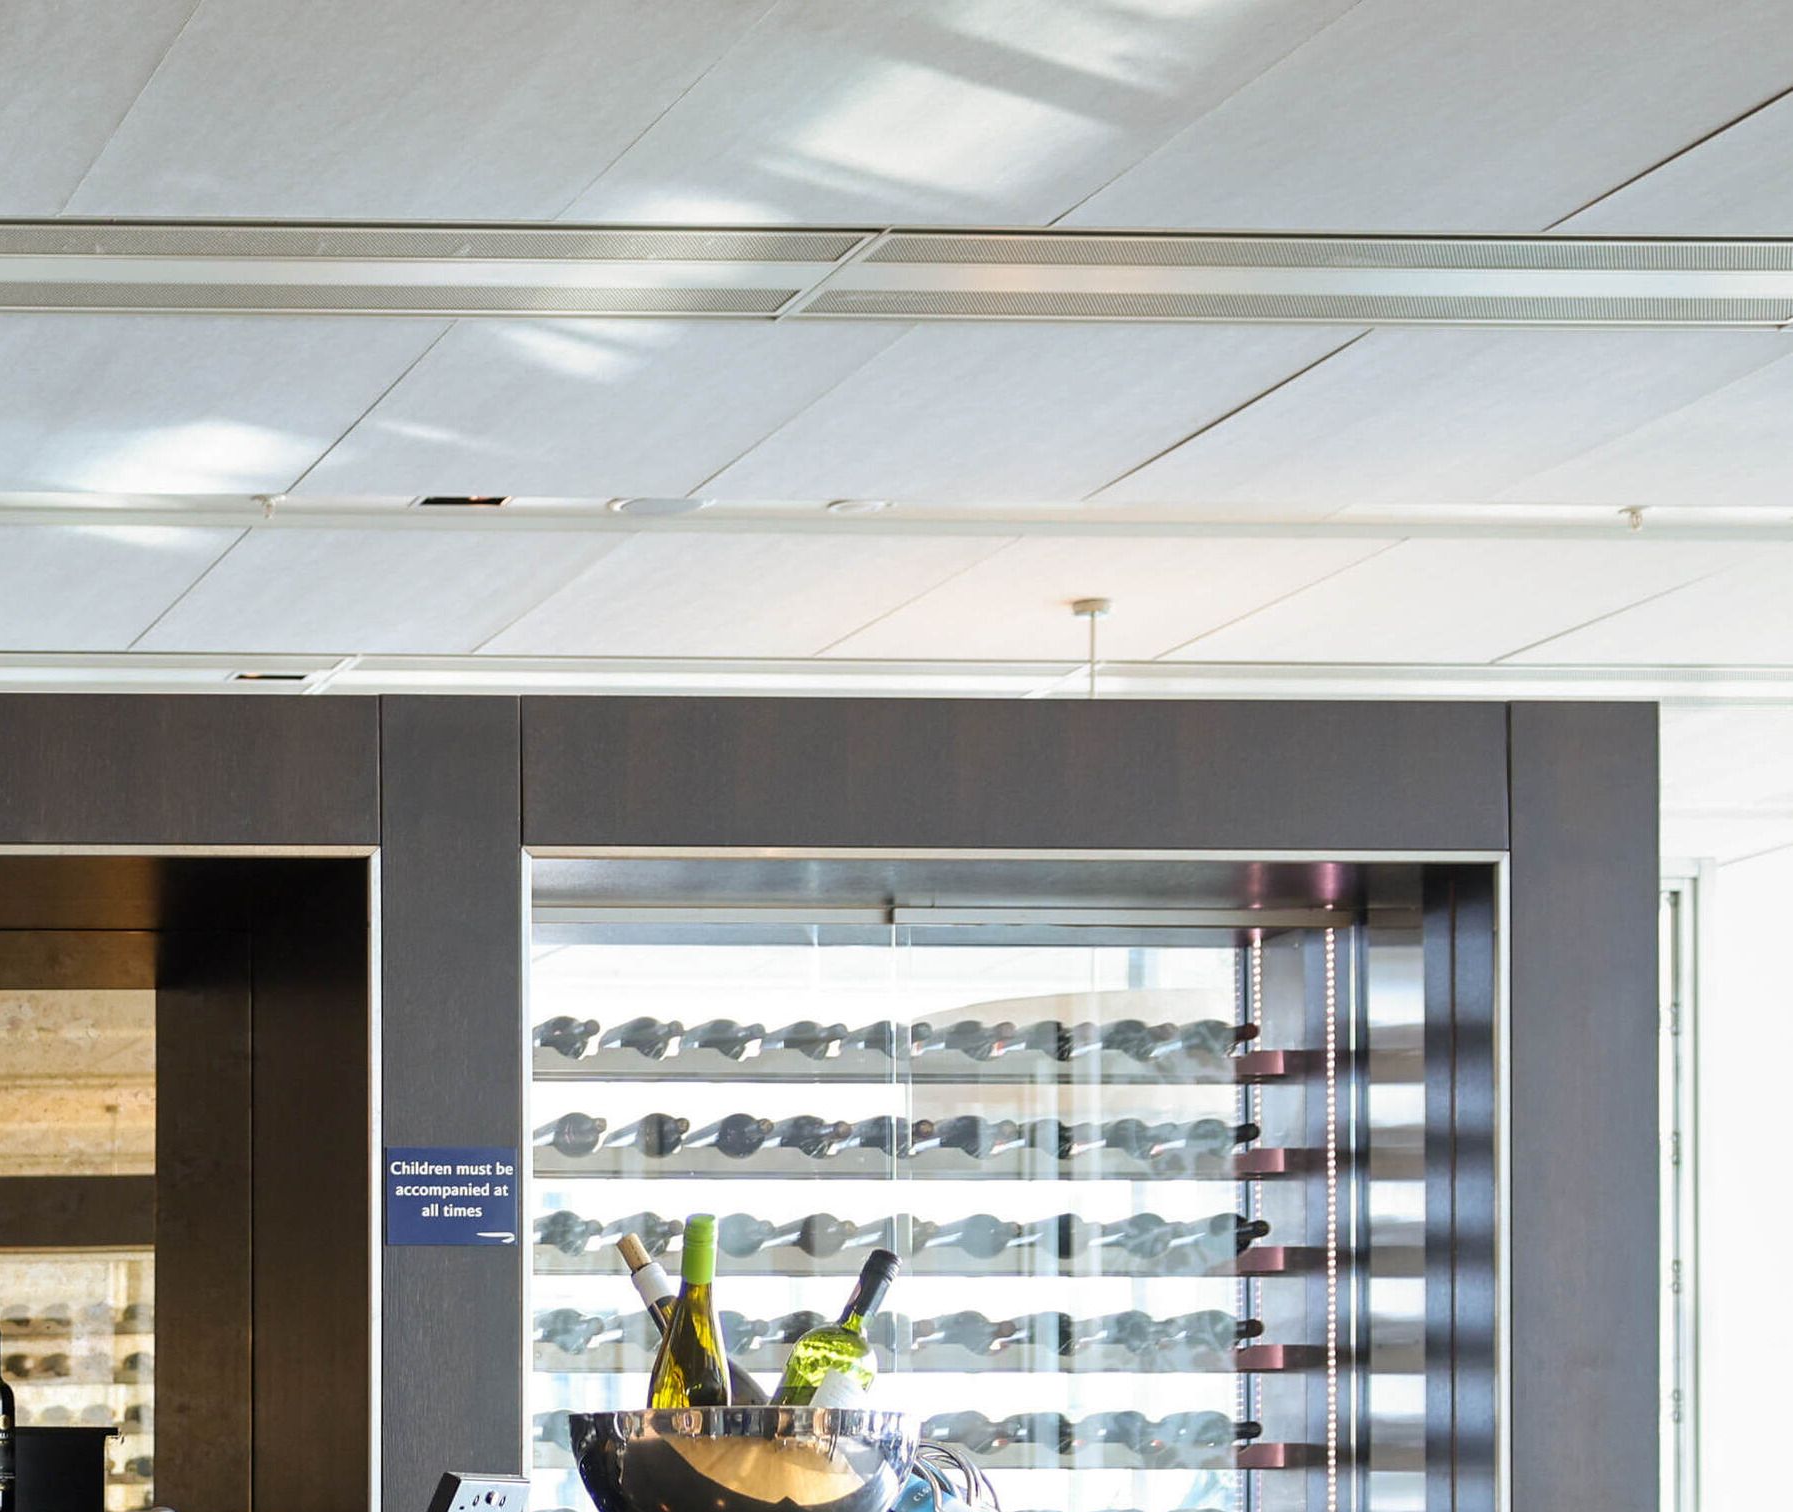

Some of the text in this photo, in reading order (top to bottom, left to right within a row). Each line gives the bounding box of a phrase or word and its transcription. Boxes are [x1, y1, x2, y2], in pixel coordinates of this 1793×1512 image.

[390, 1161, 514, 1176] Children must be
[395, 1182, 509, 1199] accompanied at
[421, 1203, 483, 1217] all times
